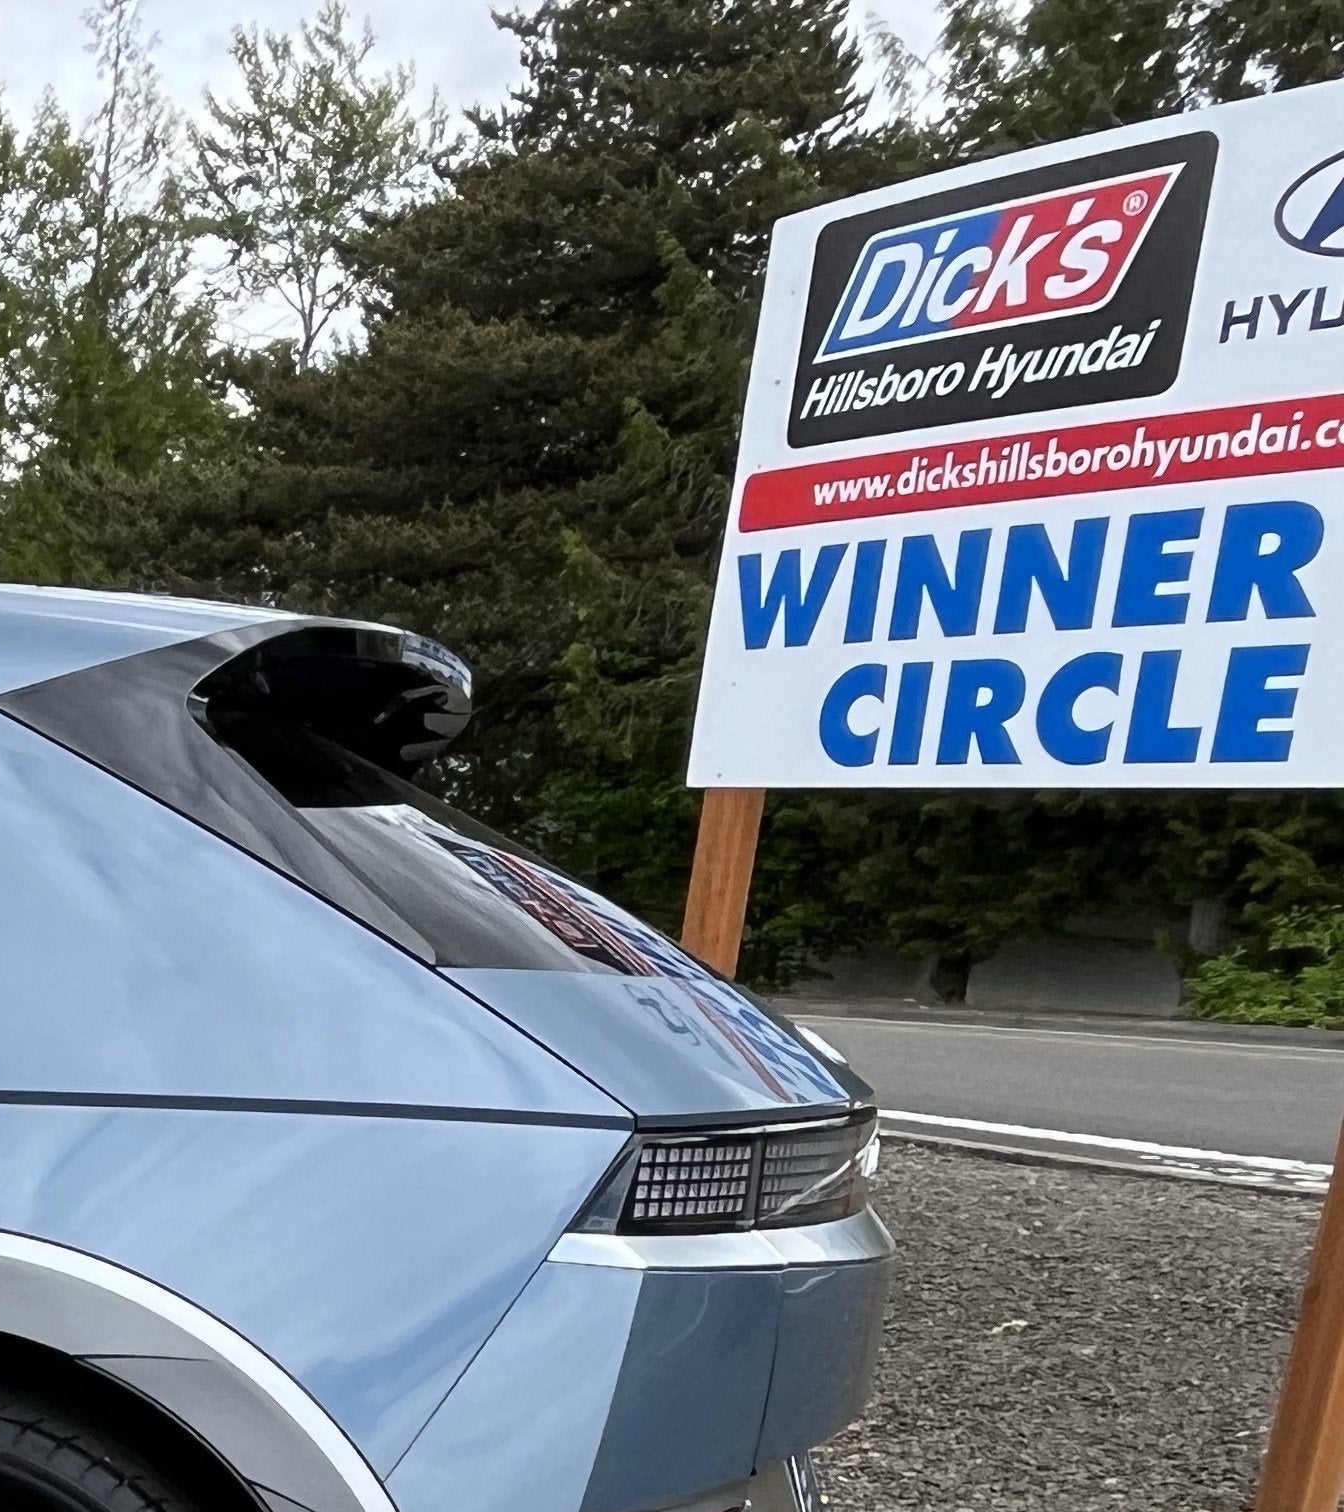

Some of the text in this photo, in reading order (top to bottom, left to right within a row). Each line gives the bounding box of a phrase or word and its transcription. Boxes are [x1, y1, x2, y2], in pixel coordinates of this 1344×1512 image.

[799, 318, 1163, 420] Hillsboro Hyundai
[813, 410, 1344, 506] www.dickshillsborohyundai.c
[737, 500, 1326, 651] WINNER
[818, 643, 1312, 768] CIRCLE
